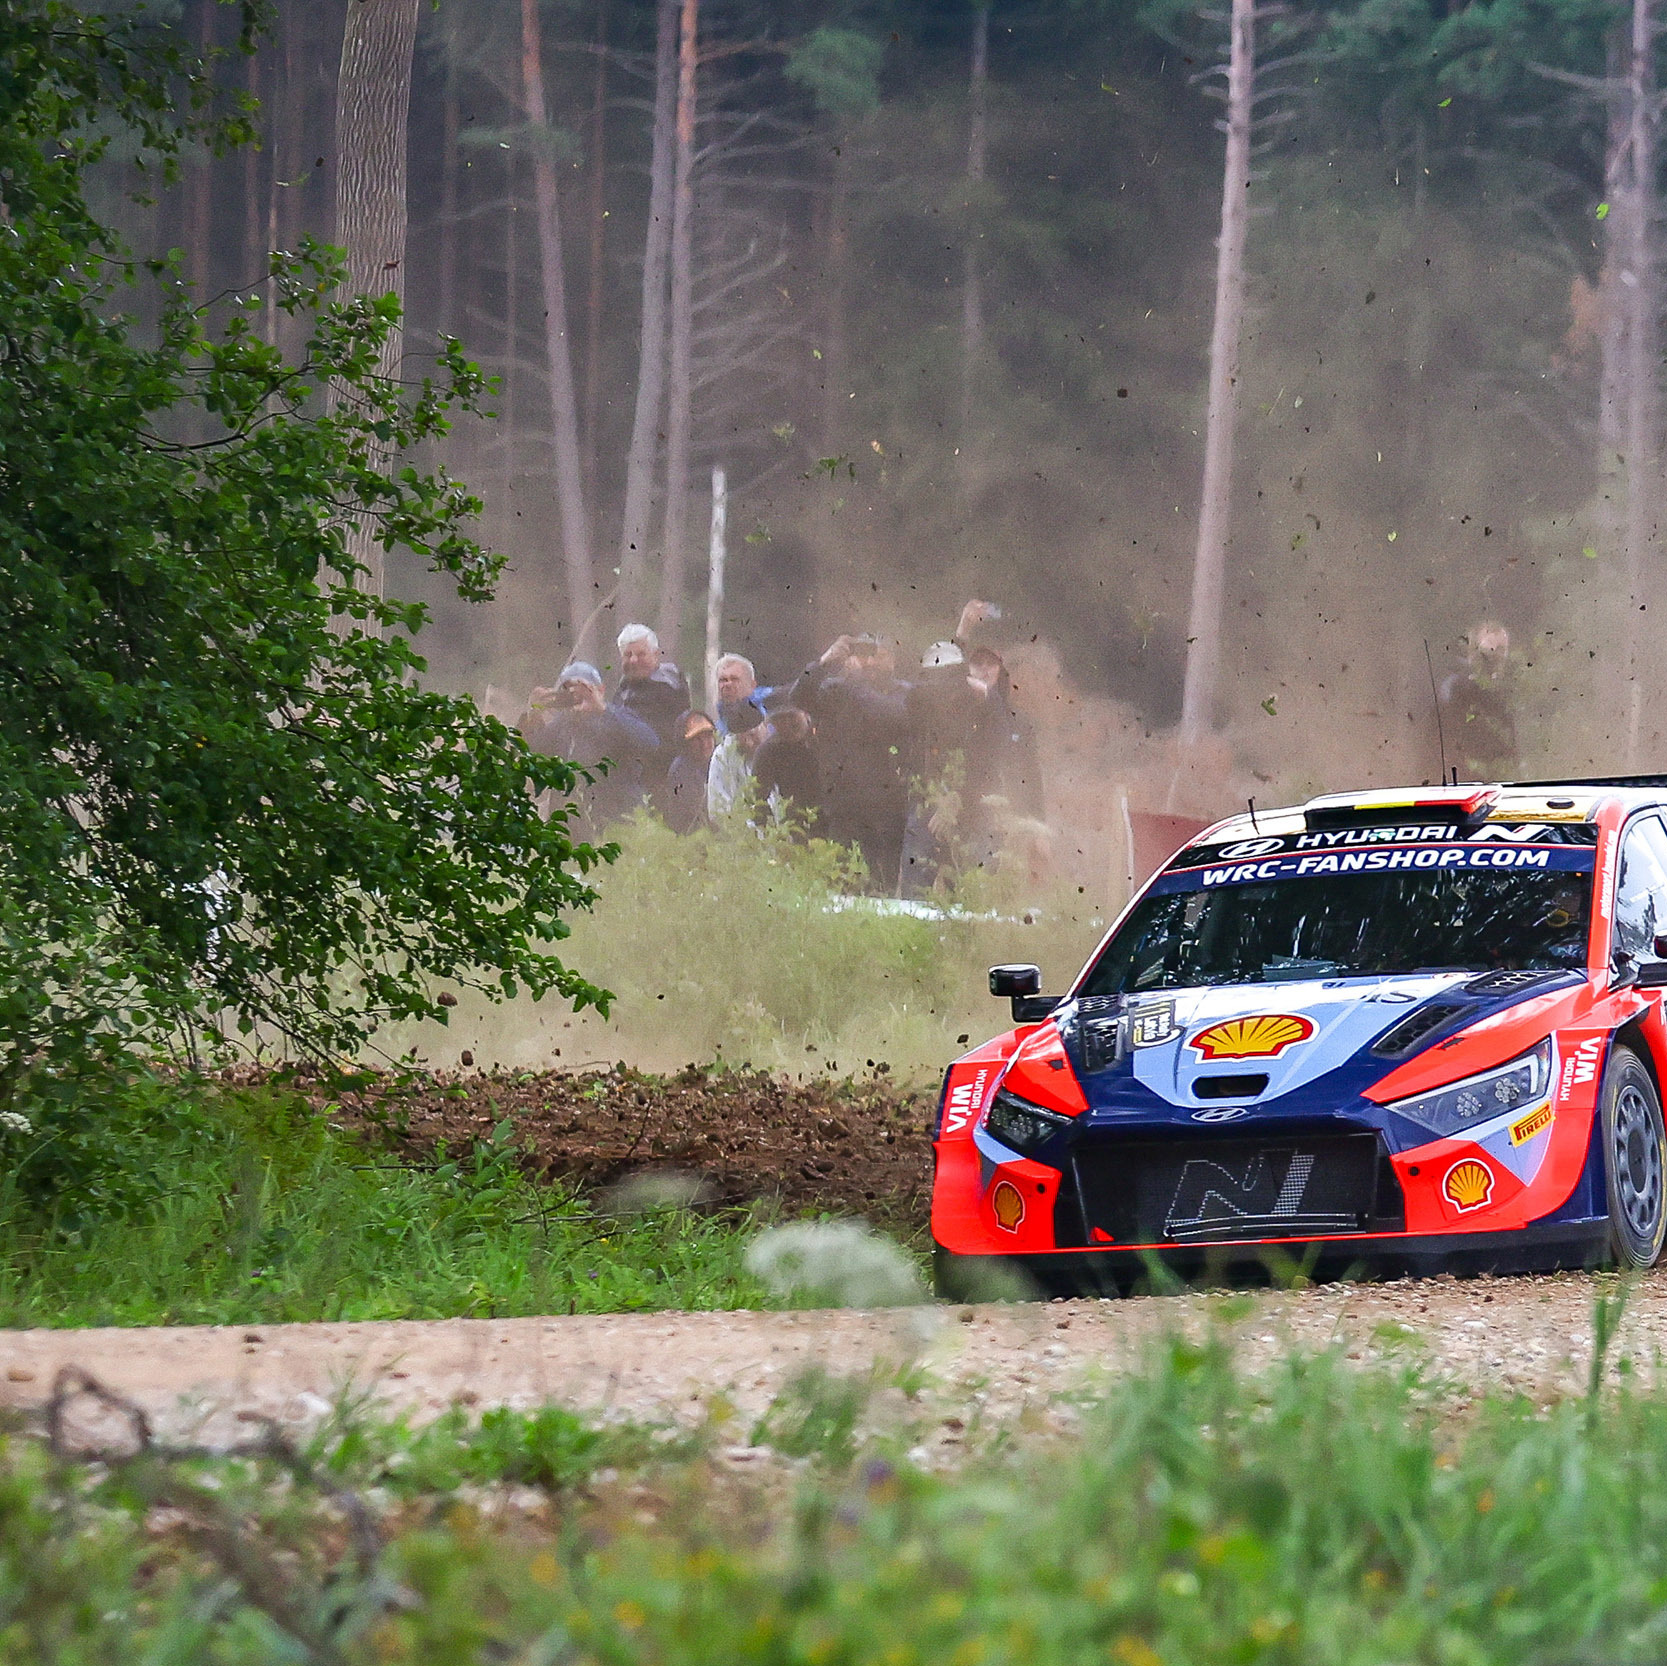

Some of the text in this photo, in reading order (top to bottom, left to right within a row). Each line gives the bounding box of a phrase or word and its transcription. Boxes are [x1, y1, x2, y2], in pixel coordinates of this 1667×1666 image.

[1296, 826, 1457, 849] HYUNDAI
[1202, 849, 1550, 886] WRC-FANSHOP.COM
[970, 1069, 989, 1109] HYUNDAI
[1560, 1057, 1576, 1101] HYUNDAI
[1513, 1104, 1552, 1141] PIRELLI
